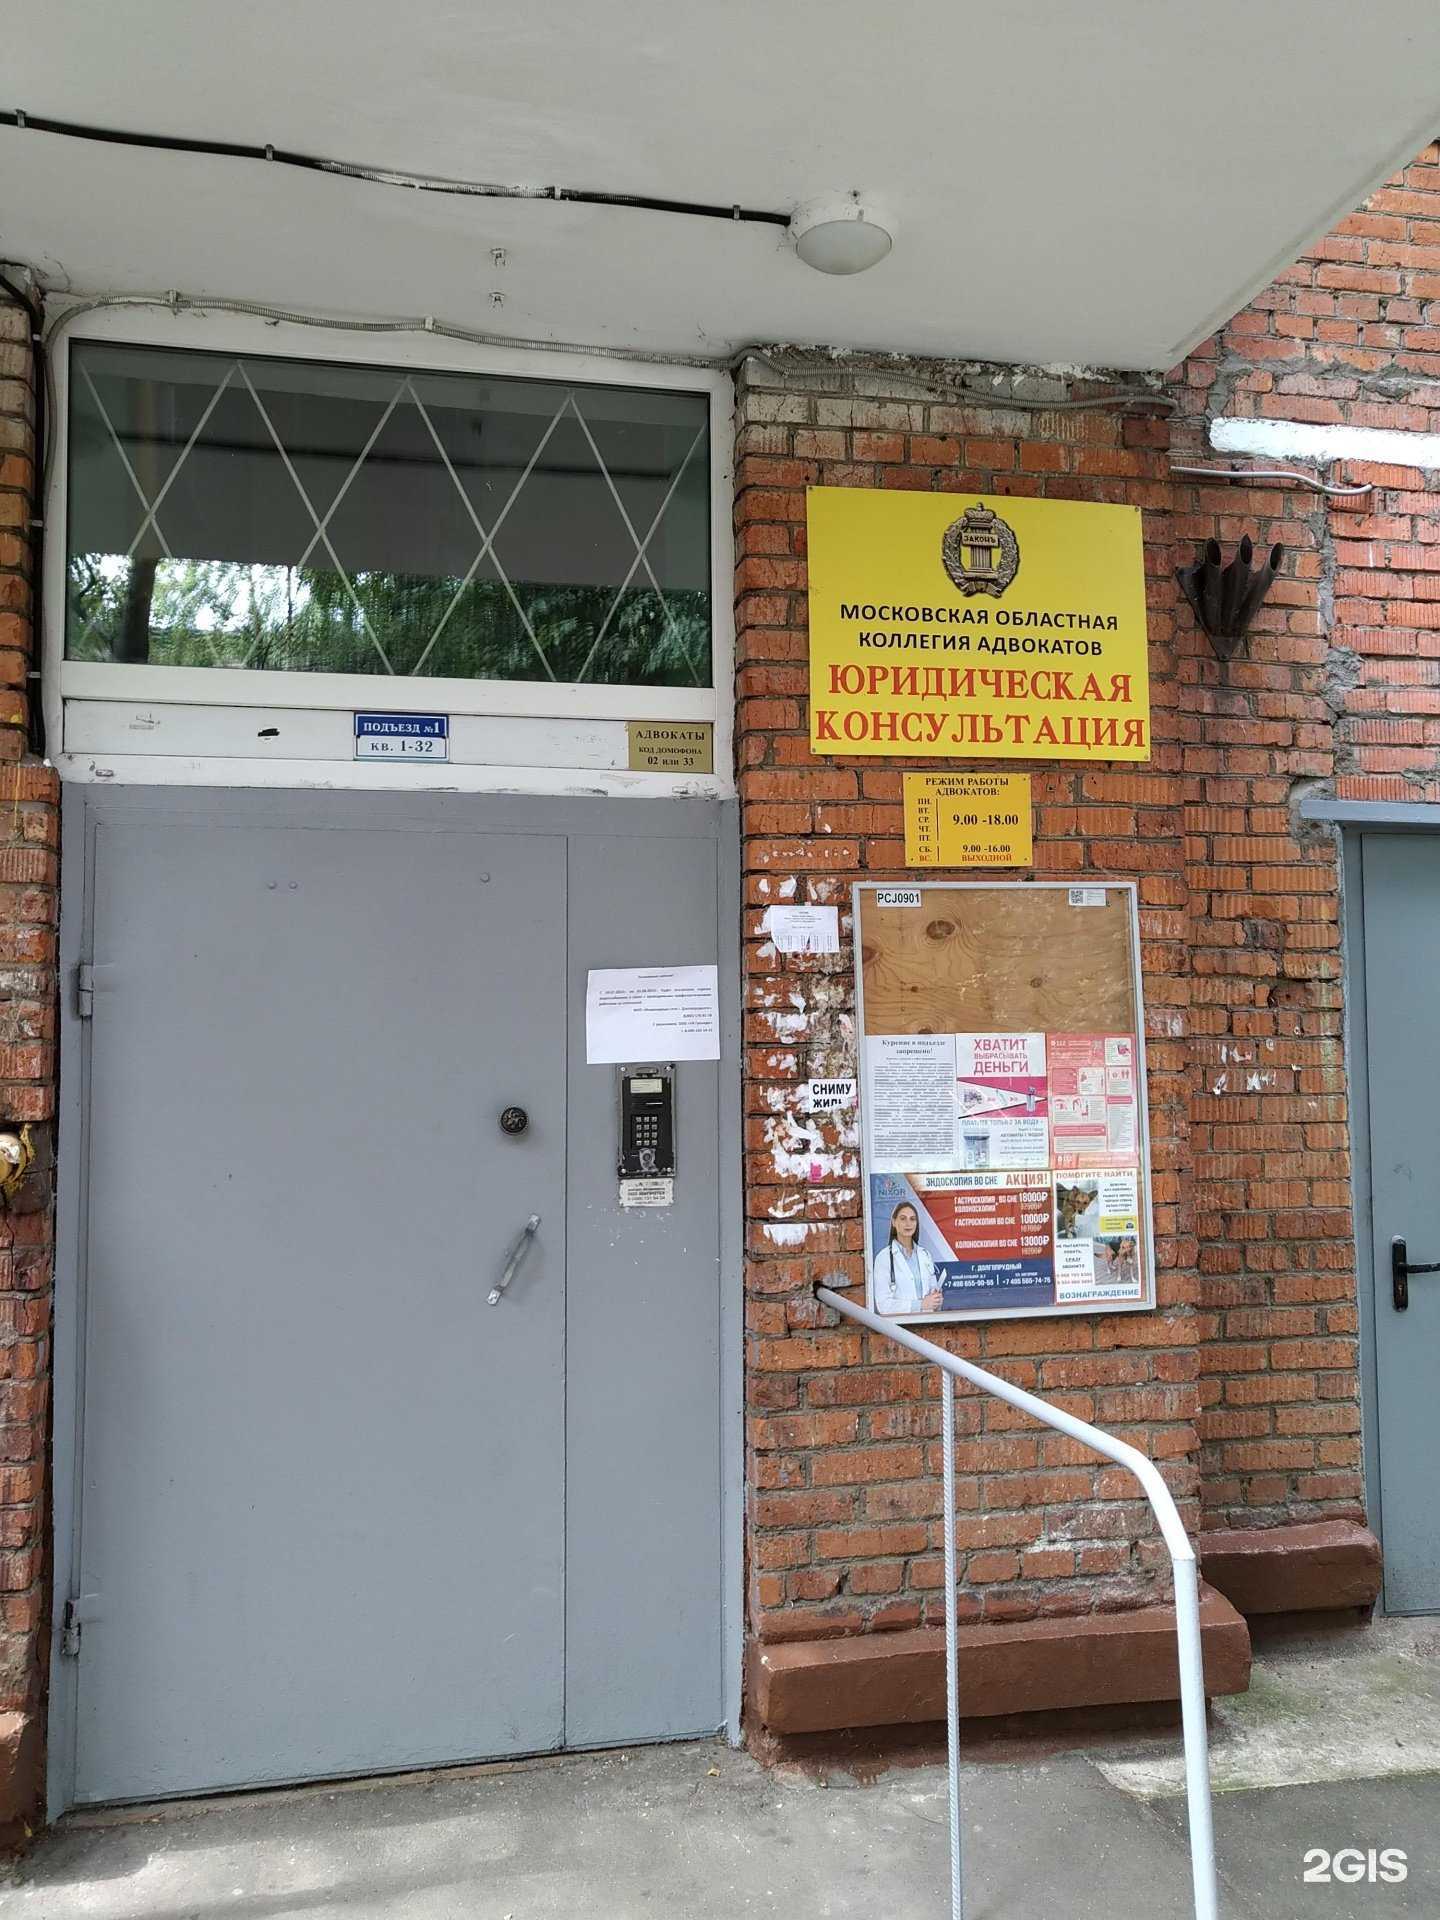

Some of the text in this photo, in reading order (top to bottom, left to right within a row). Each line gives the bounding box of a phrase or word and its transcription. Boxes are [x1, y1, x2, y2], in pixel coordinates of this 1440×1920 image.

[840, 603, 1119, 631] МОСКОВСКАЯ ОБЛАСТНАЯ
[859, 632, 1103, 656] КОЛЛЕГИЯ АДВОКАТОВ
[828, 664, 1132, 703] ЮРИДИЧЕСКАЯ
[363, 722, 420, 733] ПОДЪЕЗД
[816, 710, 1146, 750] КОНСУЛЬТАЦИЯ
[636, 730, 705, 740] АДВОКАТЫ
[400, 740, 433, 752] 1-32
[683, 757, 694, 766] 33
[925, 777, 1009, 786] РЕЖИМ РАБОТЫ
[935, 787, 1000, 796] АДВОКАТОВ:
[953, 814, 1019, 825] 9.00 -18.00
[962, 845, 981, 853] 9.00
[984, 845, 1010, 853] -16.00
[961, 854, 1012, 862] ВЫХОДНОЙ
[877, 893, 920, 904] PCJ0901
[974, 1038, 1028, 1051] ХВАТИТ
[974, 1052, 1028, 1060] ВЫБРАСЫВАТЬ
[973, 1061, 1029, 1075] ДЕНЬГИ
[812, 1083, 852, 1095] СНИМУ
[925, 1174, 1048, 1187] ЭНДОСКОПИЯ ВО СНЕ АКЦИЯ!
[1056, 1171, 1101, 1179] ПОМОГИТЕ
[1059, 1288, 1139, 1299] ВОЗНАГРАЖДЕНИЕ
